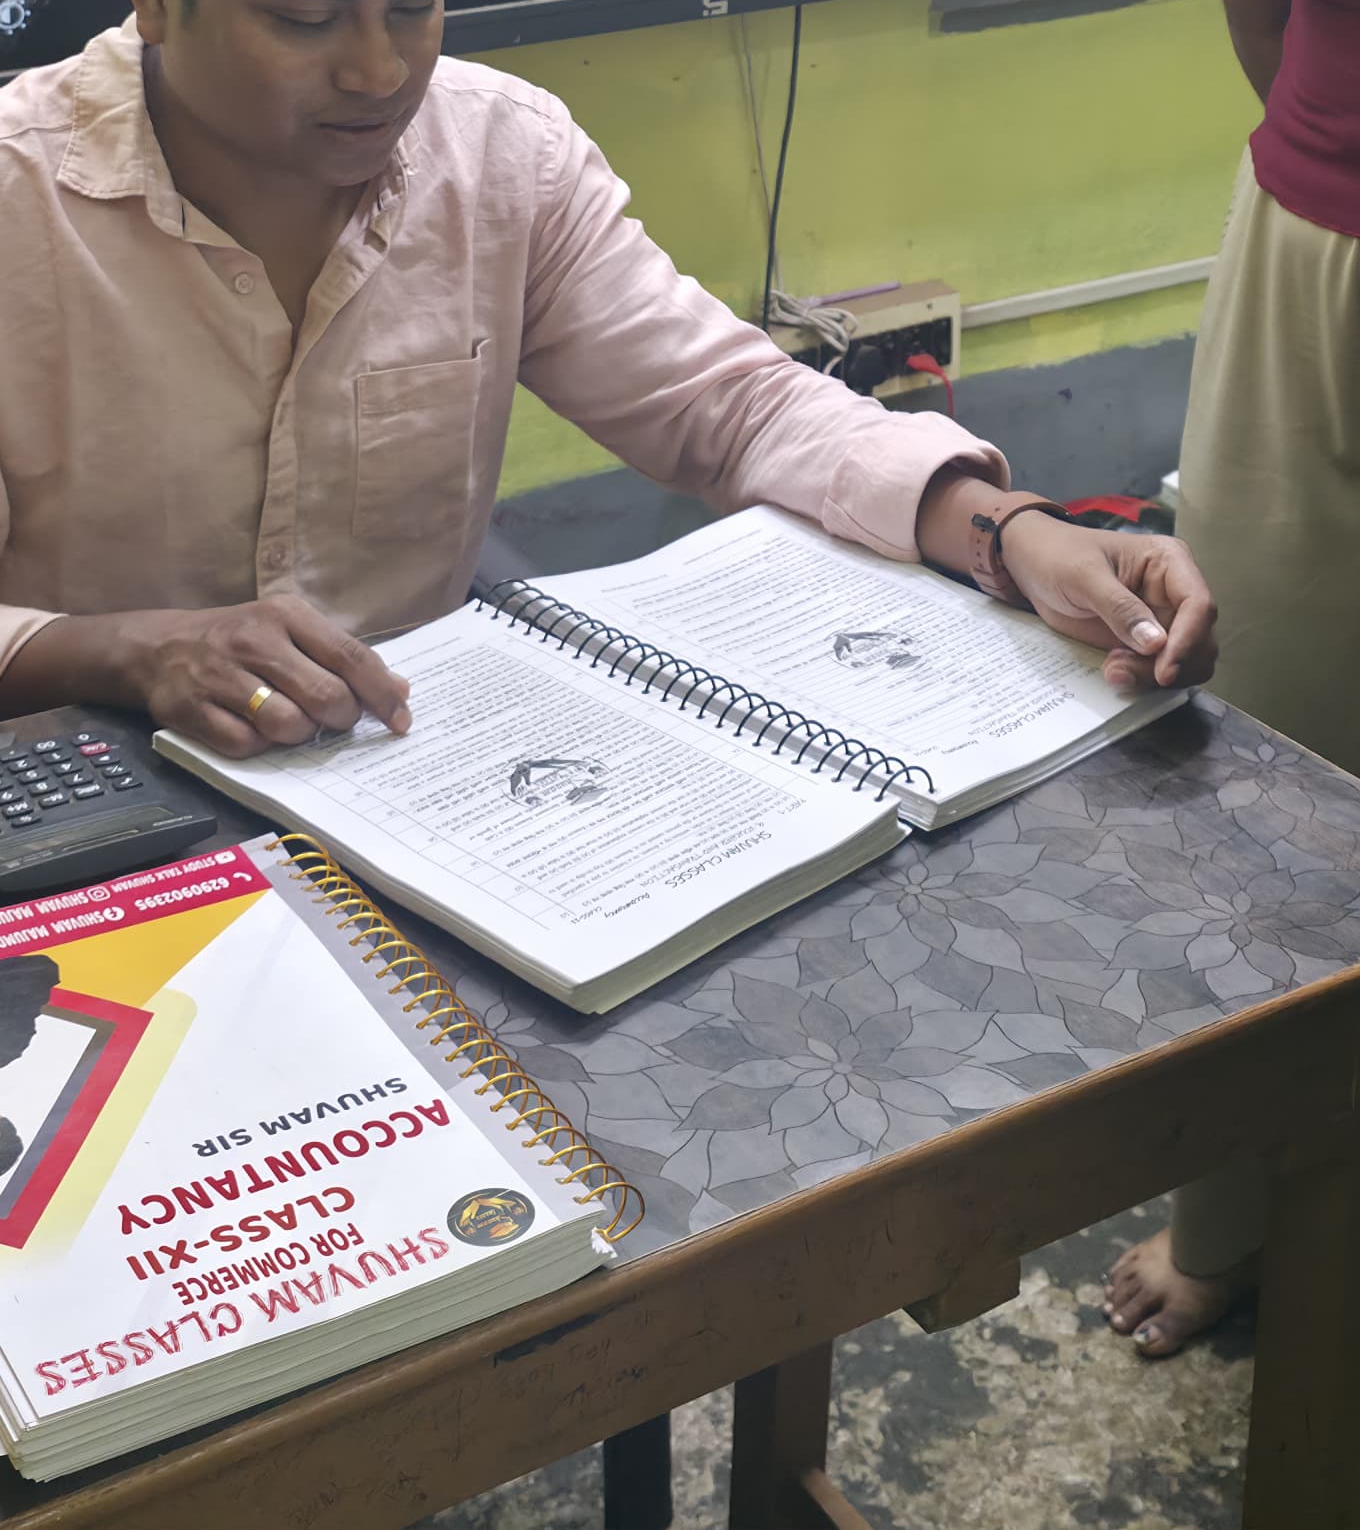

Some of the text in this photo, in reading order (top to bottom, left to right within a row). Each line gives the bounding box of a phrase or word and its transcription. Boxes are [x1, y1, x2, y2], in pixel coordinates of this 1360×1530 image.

[111, 856, 217, 893] STUDY TALK SHUVAM
[135, 876, 230, 912] 6290902395
[664, 854, 723, 889] CLASSES
[35, 891, 89, 916] SHUVAM
[51, 910, 105, 934] SHUVAM
[190, 1076, 408, 1159] SHUVAM SIR
[117, 1098, 452, 1236] ACCOUNTANCY
[125, 1185, 356, 1282] CLASS-XII
[171, 1221, 366, 1306] FOR COMMERCE
[34, 1226, 451, 1397] SHUVAM CLASSES
